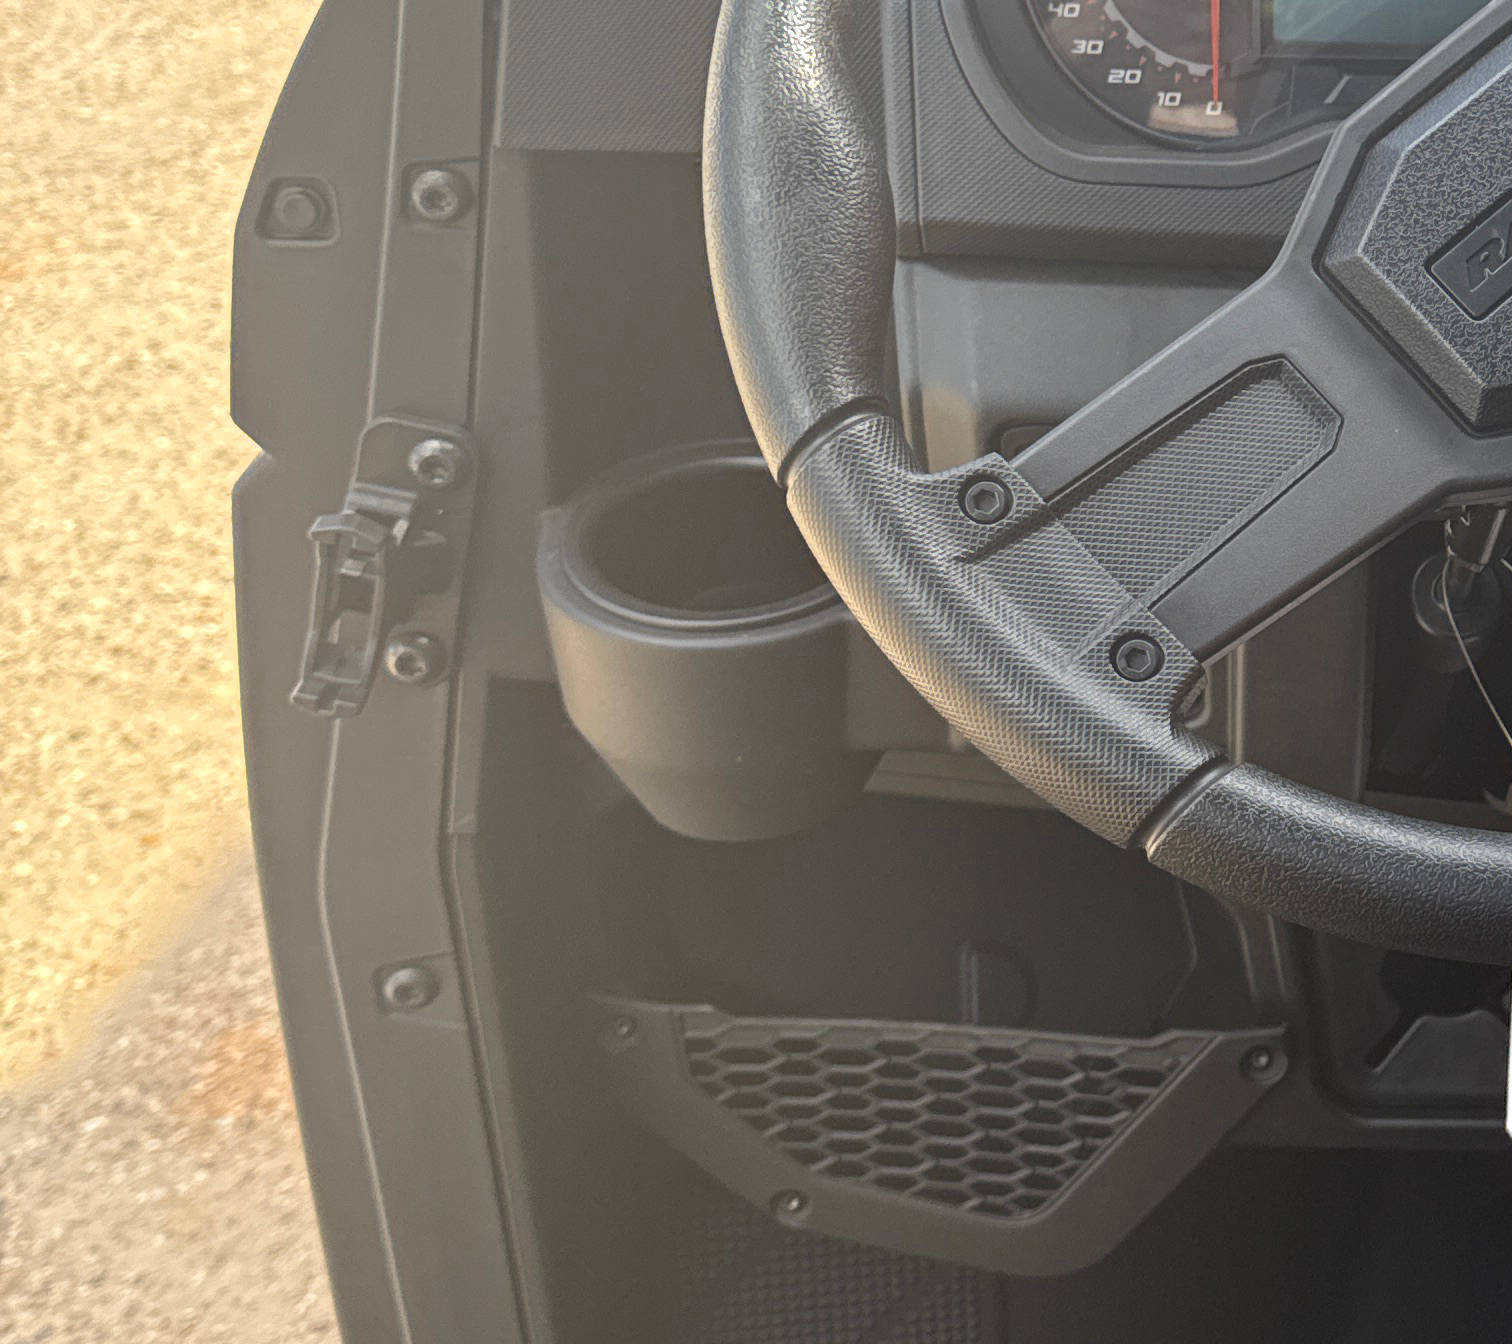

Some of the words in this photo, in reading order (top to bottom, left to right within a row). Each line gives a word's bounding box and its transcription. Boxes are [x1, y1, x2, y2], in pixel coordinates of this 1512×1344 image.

[1048, 3, 1081, 18] 40
[1071, 39, 1104, 55] 30
[1107, 69, 1142, 84] 20
[1157, 92, 1182, 106] 10
[1205, 101, 1223, 116] 0
